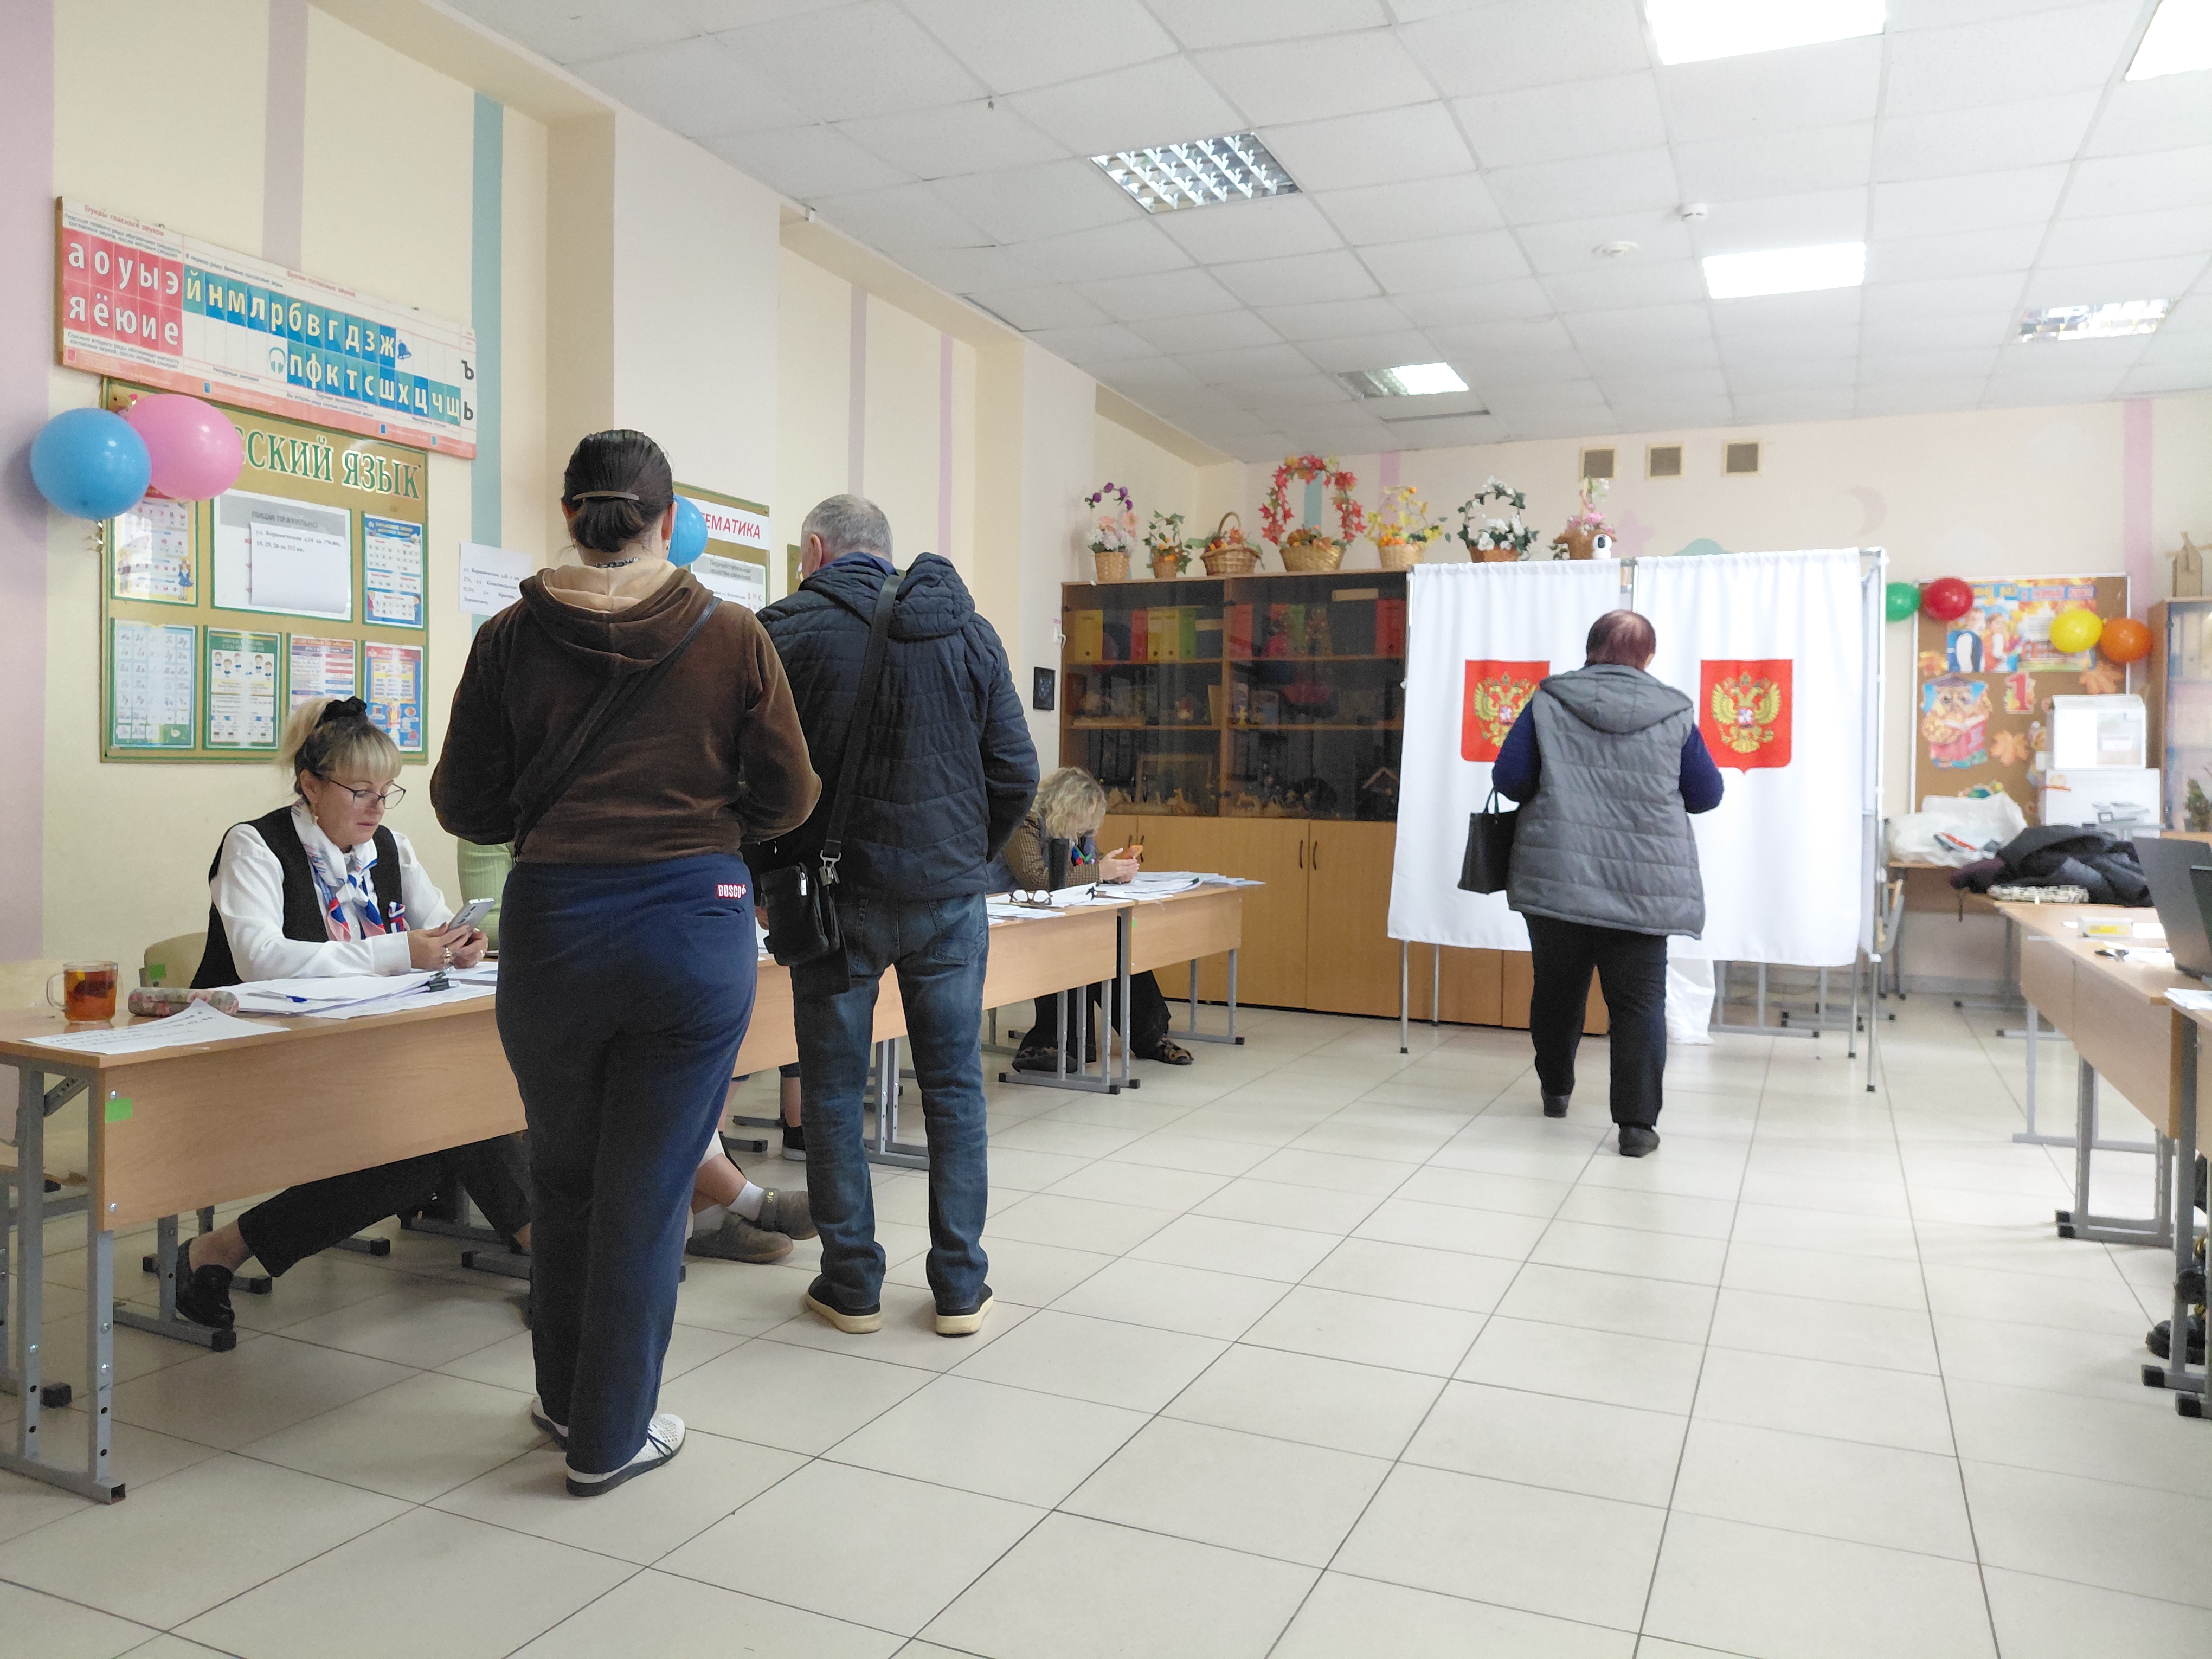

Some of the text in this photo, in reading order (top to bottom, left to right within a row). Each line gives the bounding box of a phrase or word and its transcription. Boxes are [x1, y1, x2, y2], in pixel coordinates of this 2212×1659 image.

[85, 204, 108, 218] Буквы
[110, 215, 139, 228] гласных
[235, 427, 420, 499] СКИЙ ЯЗЫК
[252, 510, 275, 522] ПИШИ
[702, 513, 760, 539] ЕМАТИКА
[718, 884, 742, 899] BOSCO
